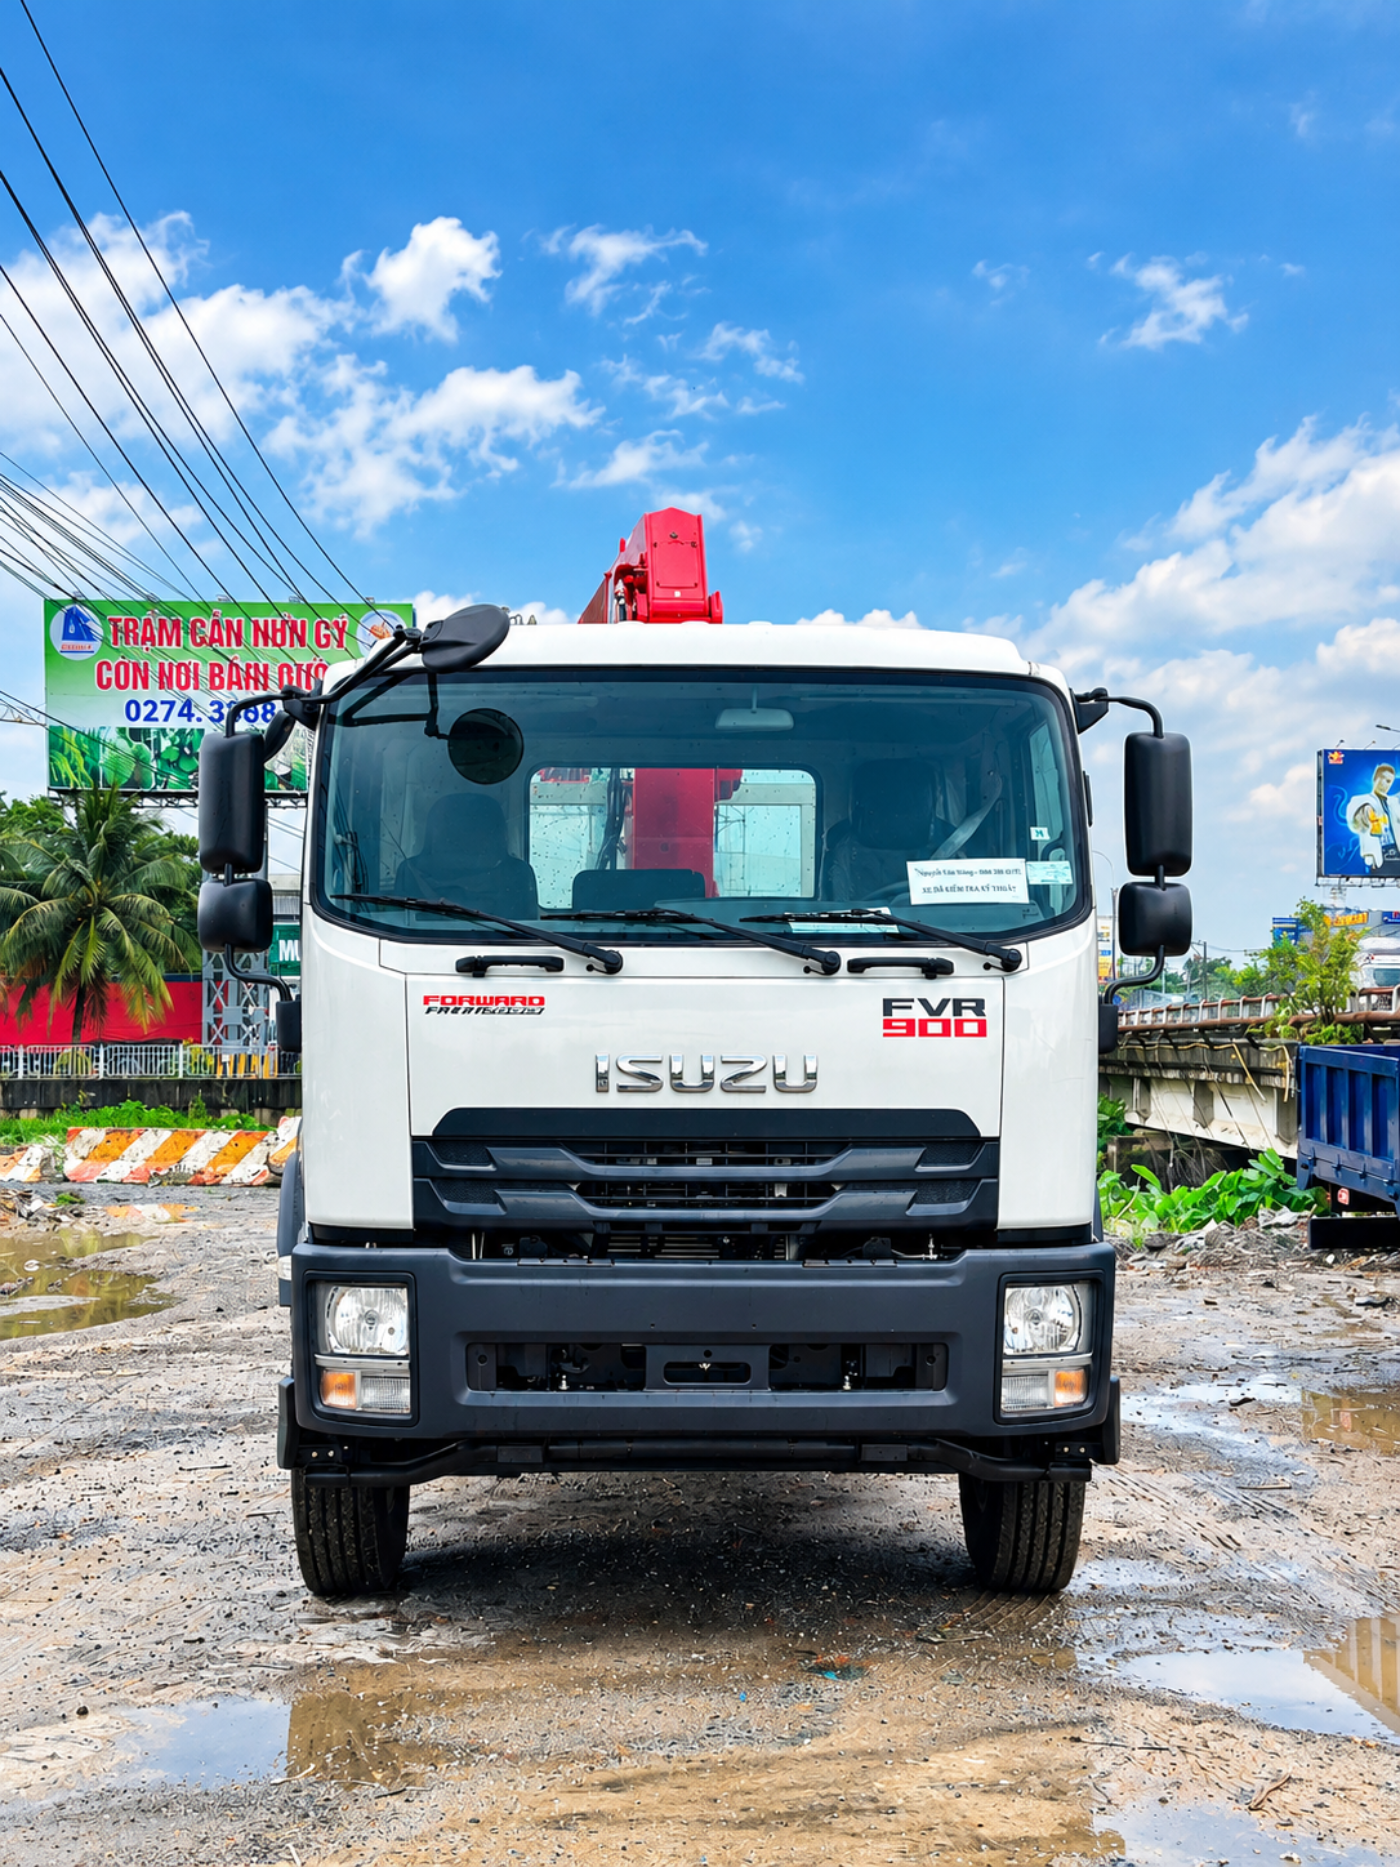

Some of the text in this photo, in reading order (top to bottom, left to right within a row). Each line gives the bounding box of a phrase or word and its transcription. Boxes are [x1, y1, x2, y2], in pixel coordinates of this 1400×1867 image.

[423, 995, 545, 1006] FORWARD
[882, 998, 986, 1016] FVR
[882, 1018, 987, 1037] 900
[595, 1054, 818, 1093] ISUZU
